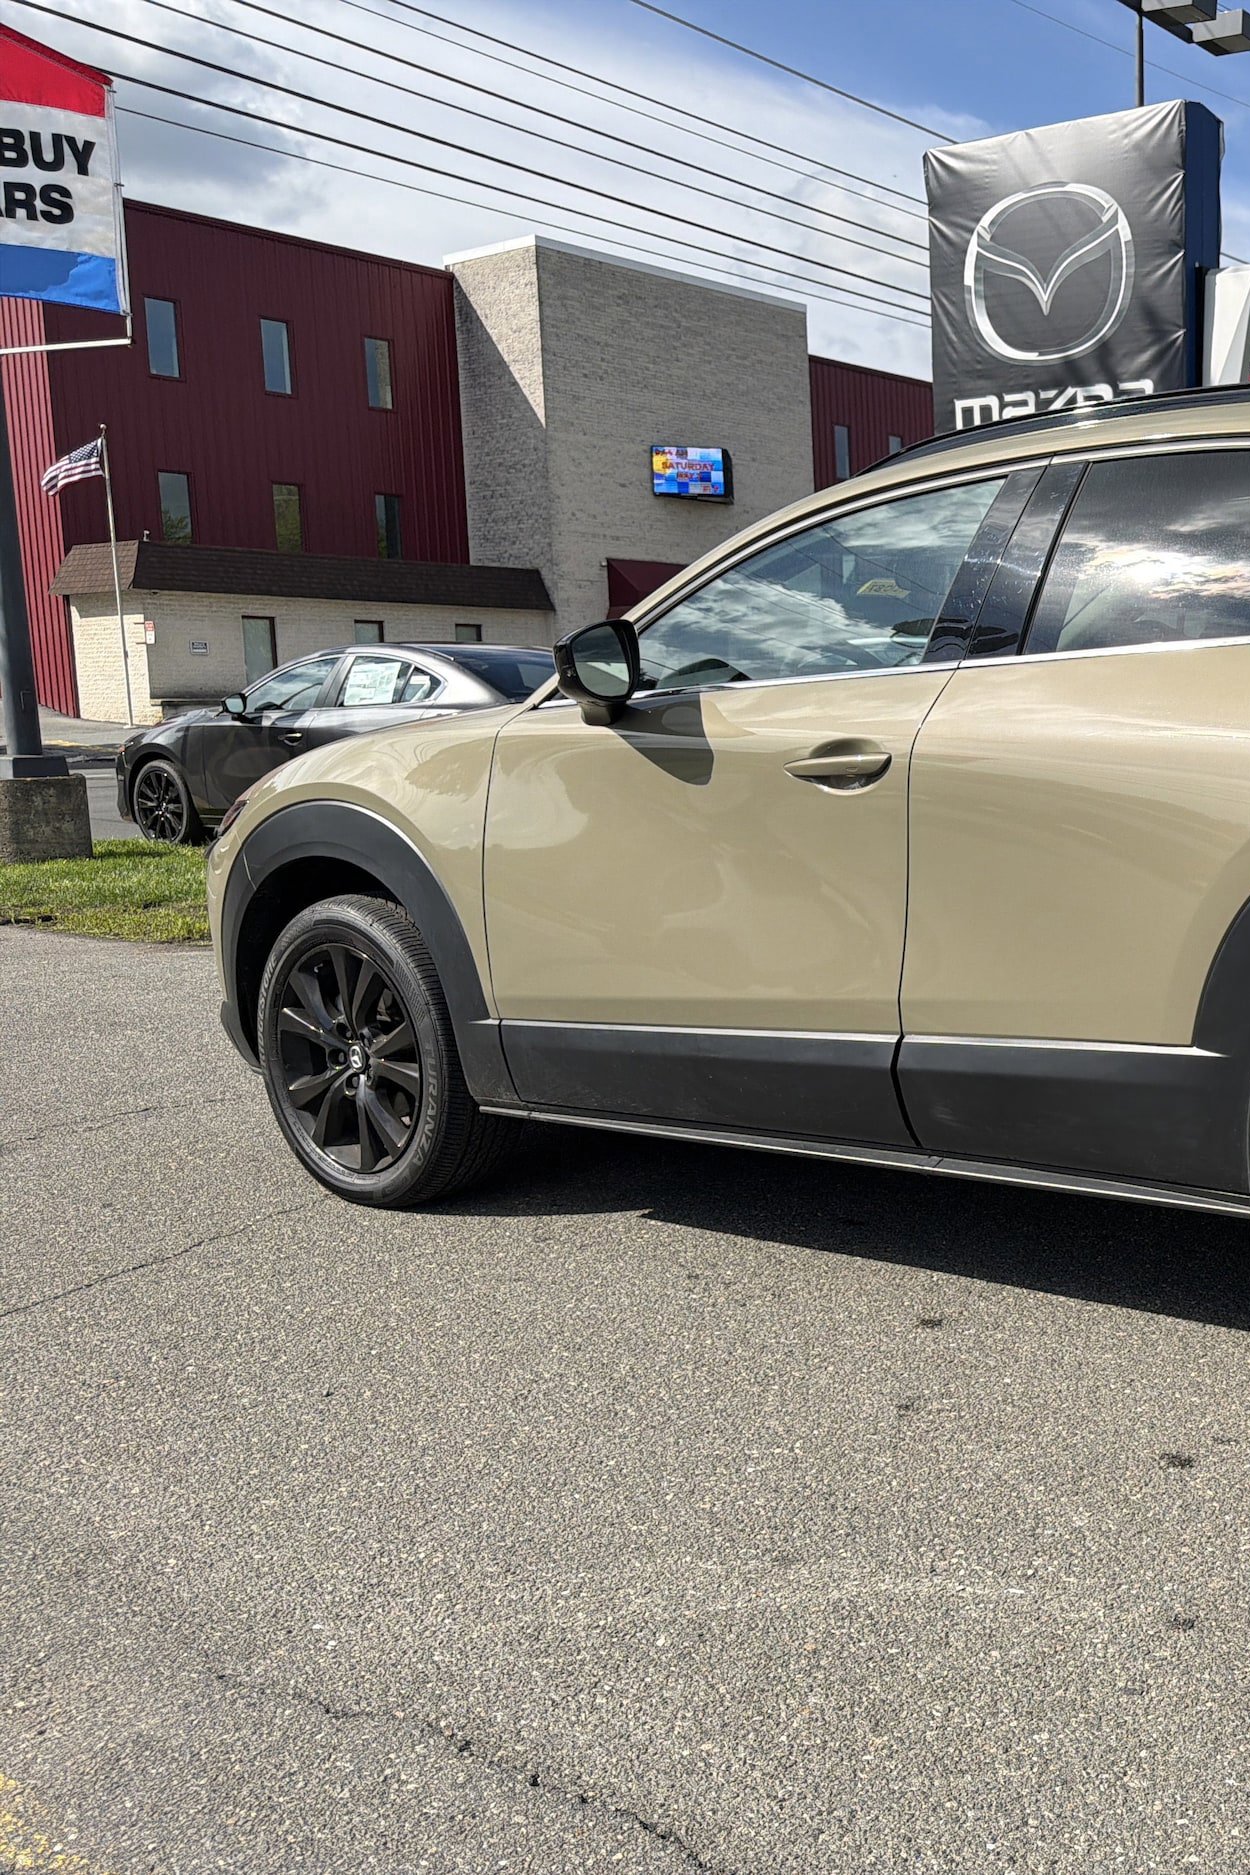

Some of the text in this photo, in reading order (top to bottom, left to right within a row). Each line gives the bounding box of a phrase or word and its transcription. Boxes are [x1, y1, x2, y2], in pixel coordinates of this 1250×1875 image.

[0, 128, 96, 176] BUY
[0, 182, 74, 225] RS
[661, 461, 715, 471] SATURDAY
[411, 1042, 438, 1167] TURANZA
